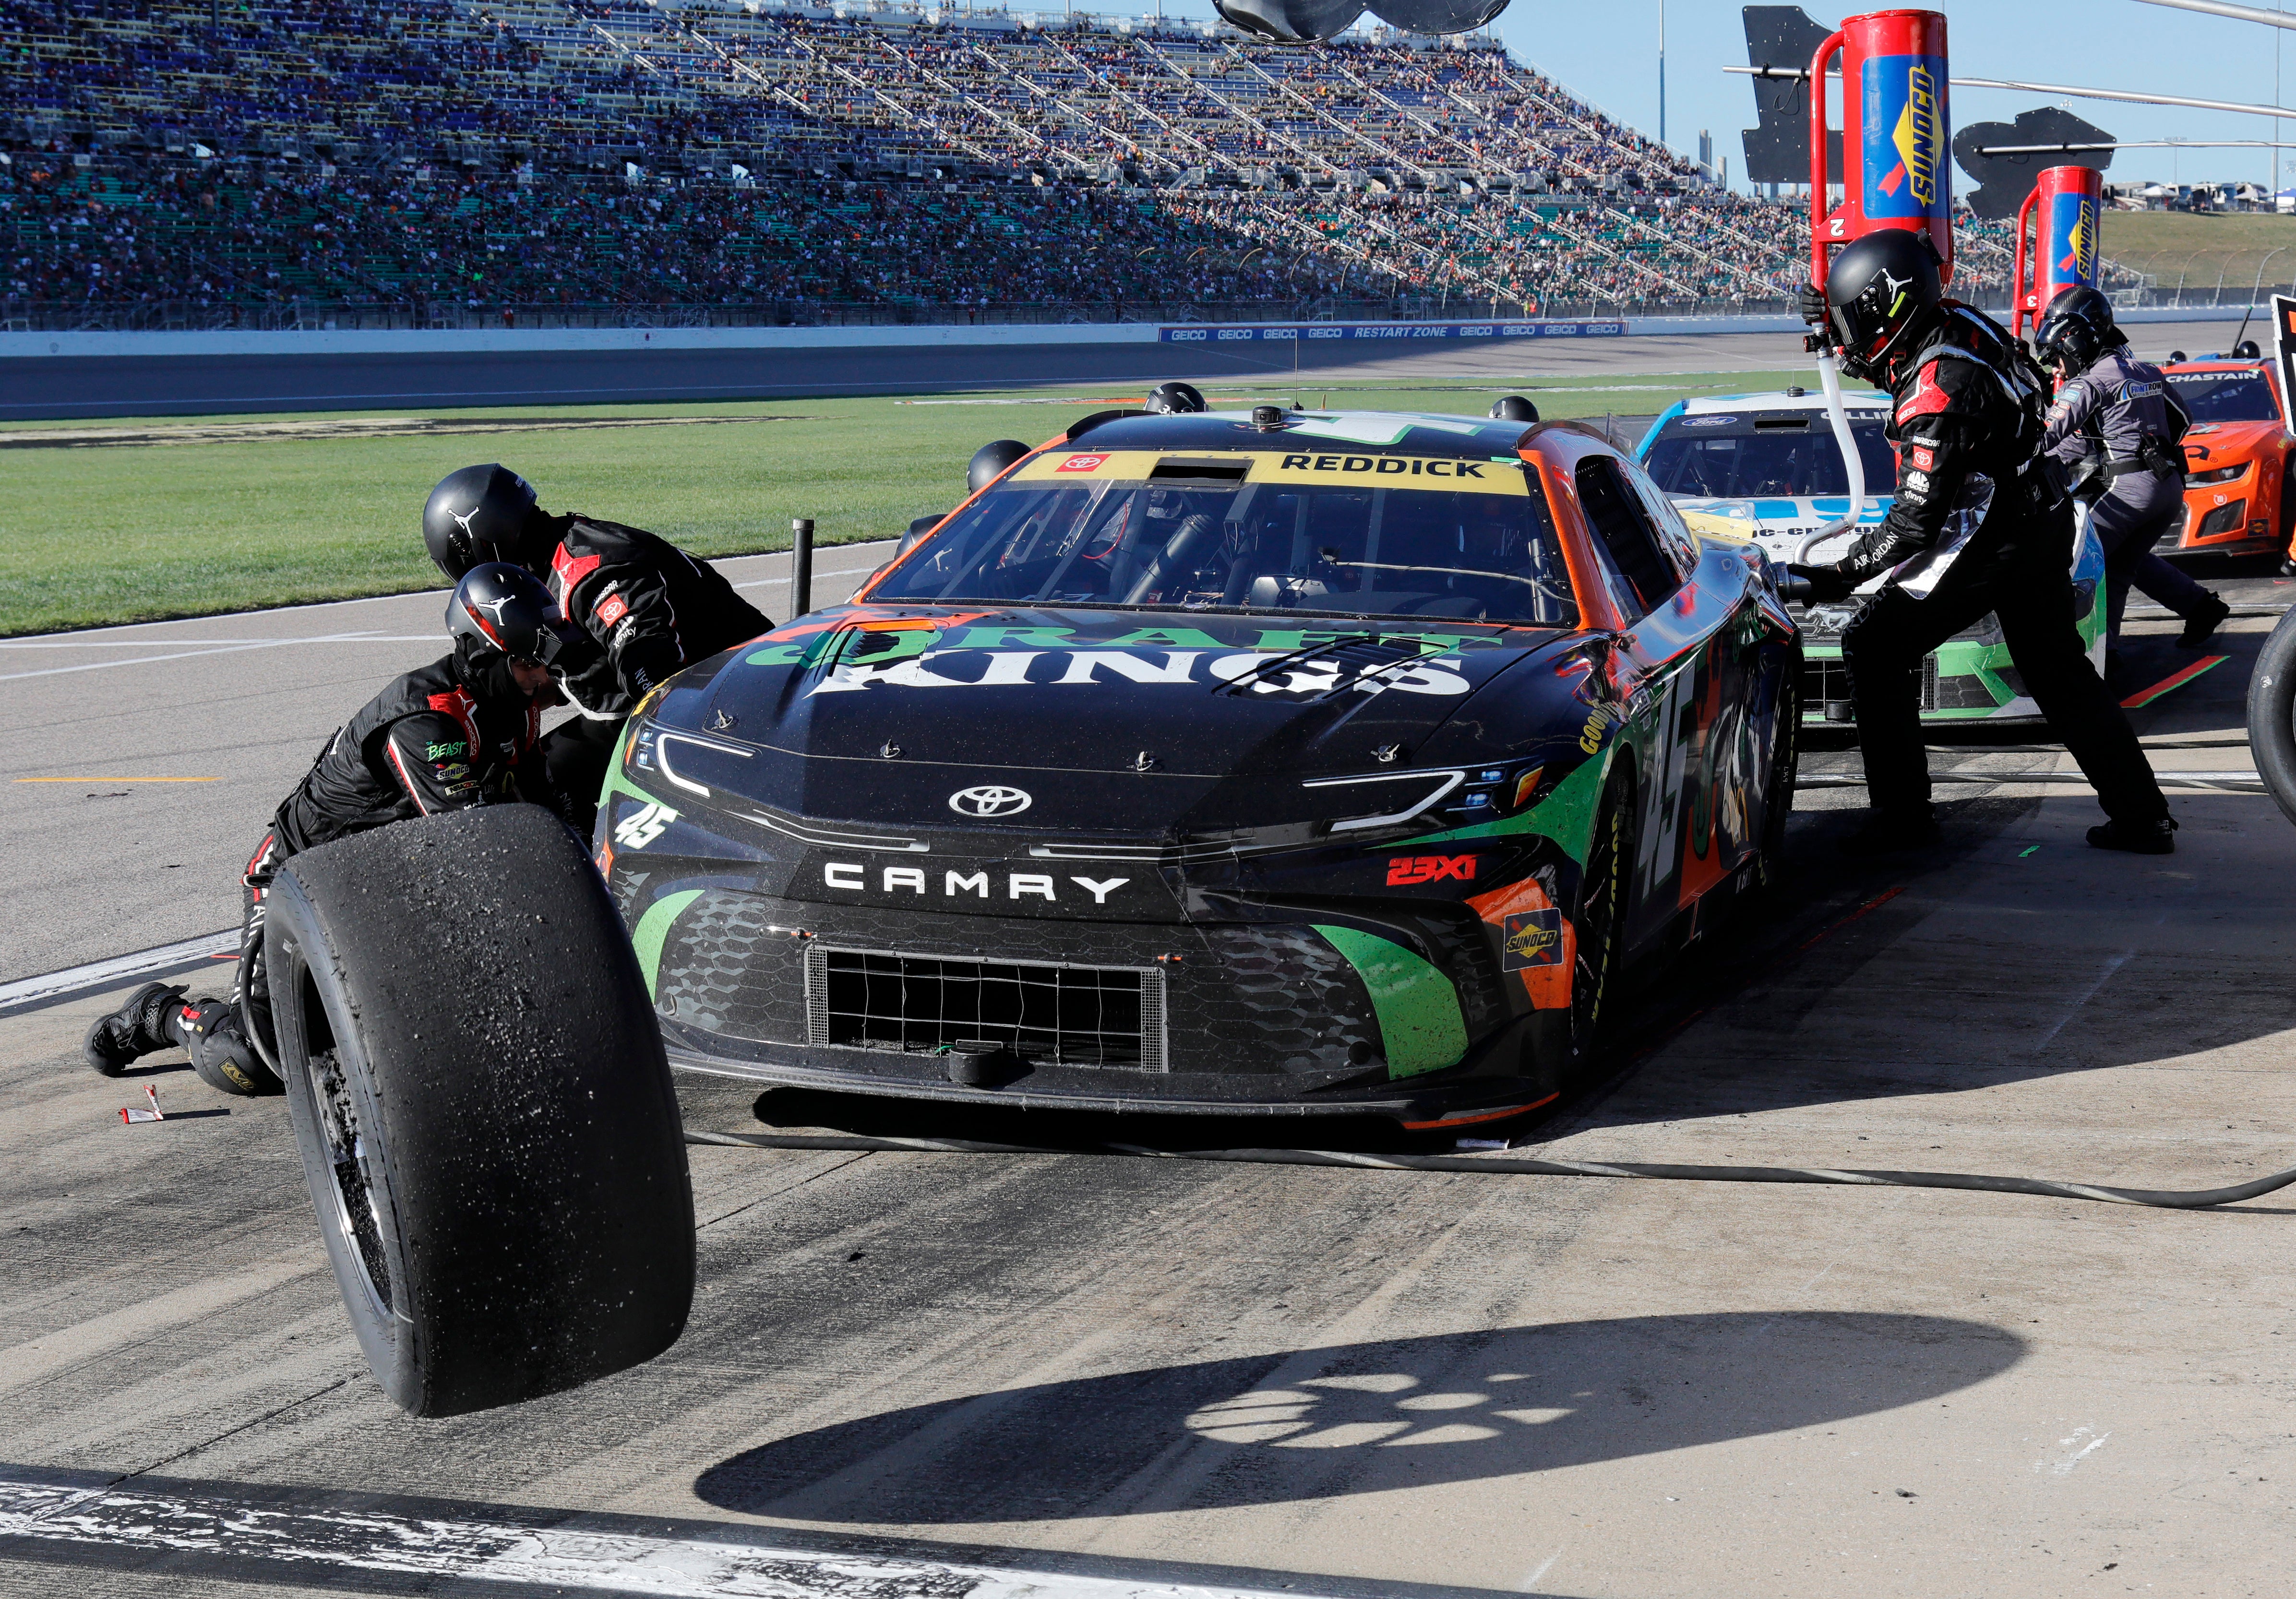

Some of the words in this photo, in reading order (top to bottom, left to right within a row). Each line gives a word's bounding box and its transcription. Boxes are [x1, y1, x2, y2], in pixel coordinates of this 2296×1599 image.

[1912, 72, 1934, 198] SUNOCO
[1829, 217, 1845, 237] 2
[2079, 203, 2094, 278] SUNOCO
[2027, 295, 2038, 307] 3
[1171, 330, 1207, 341] GEICO
[1218, 329, 1253, 340] GEICO
[1263, 329, 1297, 339] GEICO
[1308, 328, 1343, 338] GEICO
[1354, 326, 1412, 338] RESTART
[1412, 326, 1448, 337] ZONE
[1459, 326, 1493, 336] GEICO
[1503, 325, 1535, 335] GEICO
[1544, 325, 1577, 334] GEICO
[1586, 324, 1619, 334] GEICO
[2165, 372, 2258, 383] CHASTAIN
[1913, 436, 1941, 447] NASCAR
[1280, 454, 1486, 479] REDDICK
[1906, 482, 1929, 493] TOOLS
[1907, 471, 1930, 488] MAC
[1904, 490, 1927, 505] xfinity
[1854, 553, 1871, 570] AIR
[1870, 531, 1899, 564] JORDAN
[613, 627, 636, 649] xfinity
[802, 649, 1471, 700] KINGS
[424, 741, 467, 762] BEAST
[439, 764, 469, 778] SUNOCO
[614, 802, 680, 849] 45
[1386, 853, 1486, 886] 23XI
[824, 862, 1131, 904] CAMRY
[1508, 930, 1557, 953] SUNOCO
